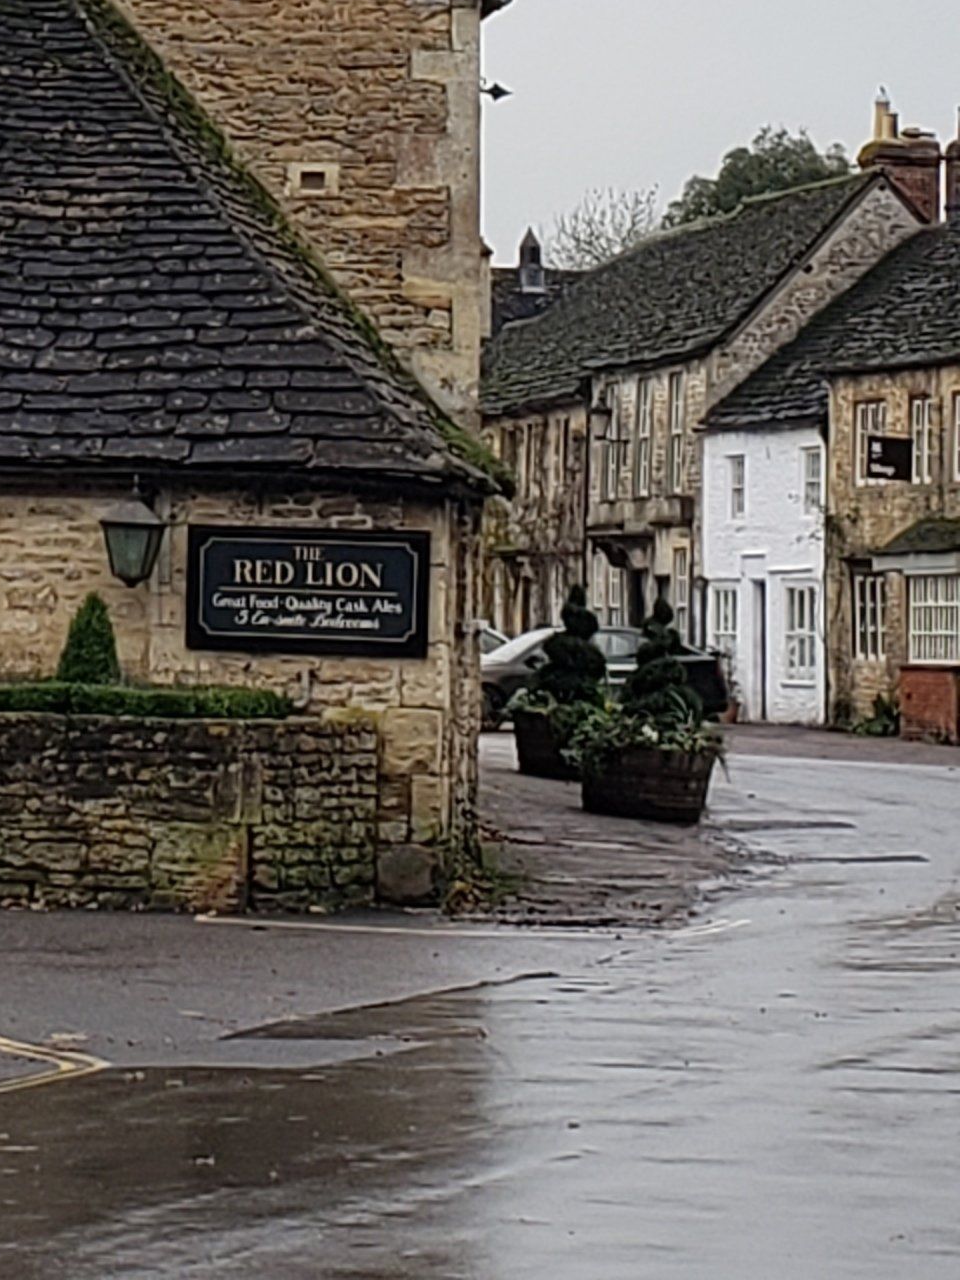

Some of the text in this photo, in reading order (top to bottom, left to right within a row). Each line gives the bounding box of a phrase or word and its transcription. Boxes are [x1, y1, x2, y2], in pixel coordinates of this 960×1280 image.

[293, 546, 325, 561] THE
[234, 559, 383, 588] RED LION
[212, 592, 403, 615] Great Food Quality Cask Ales
